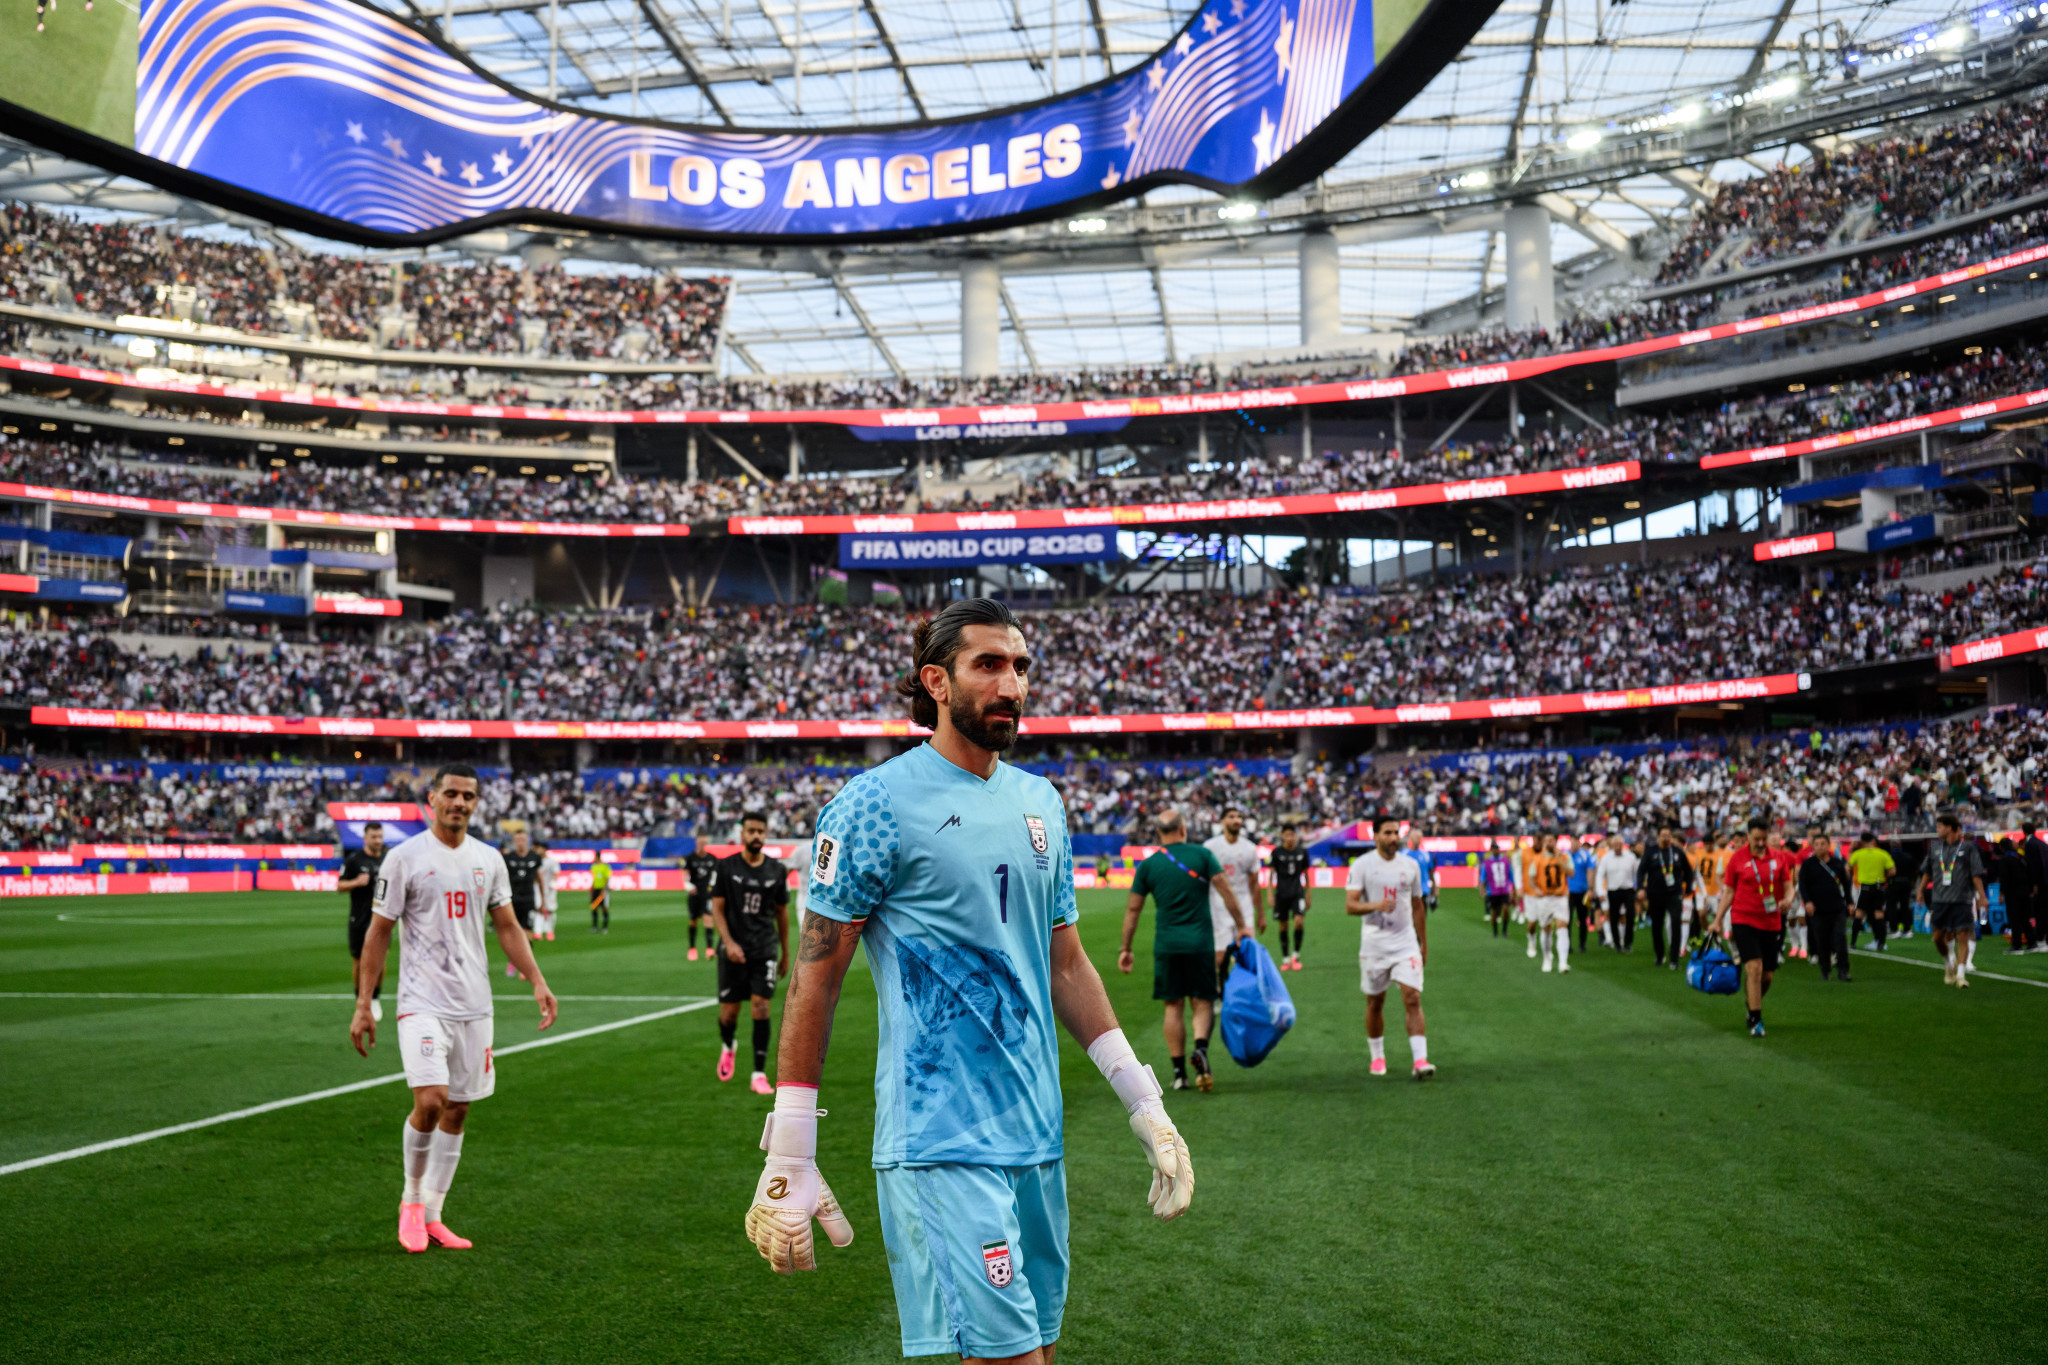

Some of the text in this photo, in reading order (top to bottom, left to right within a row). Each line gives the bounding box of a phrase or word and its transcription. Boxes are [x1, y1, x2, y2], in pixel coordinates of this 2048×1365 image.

[628, 122, 1083, 209] LOS ANGELES
[1447, 364, 1508, 388] verizon
[1346, 378, 1406, 400] verizon
[880, 408, 940, 427] verizon
[979, 405, 1038, 423] verizon
[915, 421, 1067, 440] LOS ANGELES
[1562, 464, 1626, 489] verizon
[1335, 489, 1397, 511] verizon
[1443, 478, 1507, 501] verizon
[741, 518, 803, 534] verizon
[853, 514, 914, 532] verizon
[956, 511, 1017, 530] verizon
[852, 533, 1105, 560] FIFA WORLD CUP 2026
[1770, 536, 1818, 559] verizon
[1965, 640, 2004, 663] verizon
[743, 892, 761, 914] 10
[993, 863, 1009, 924] 1
[445, 891, 467, 919] 19
